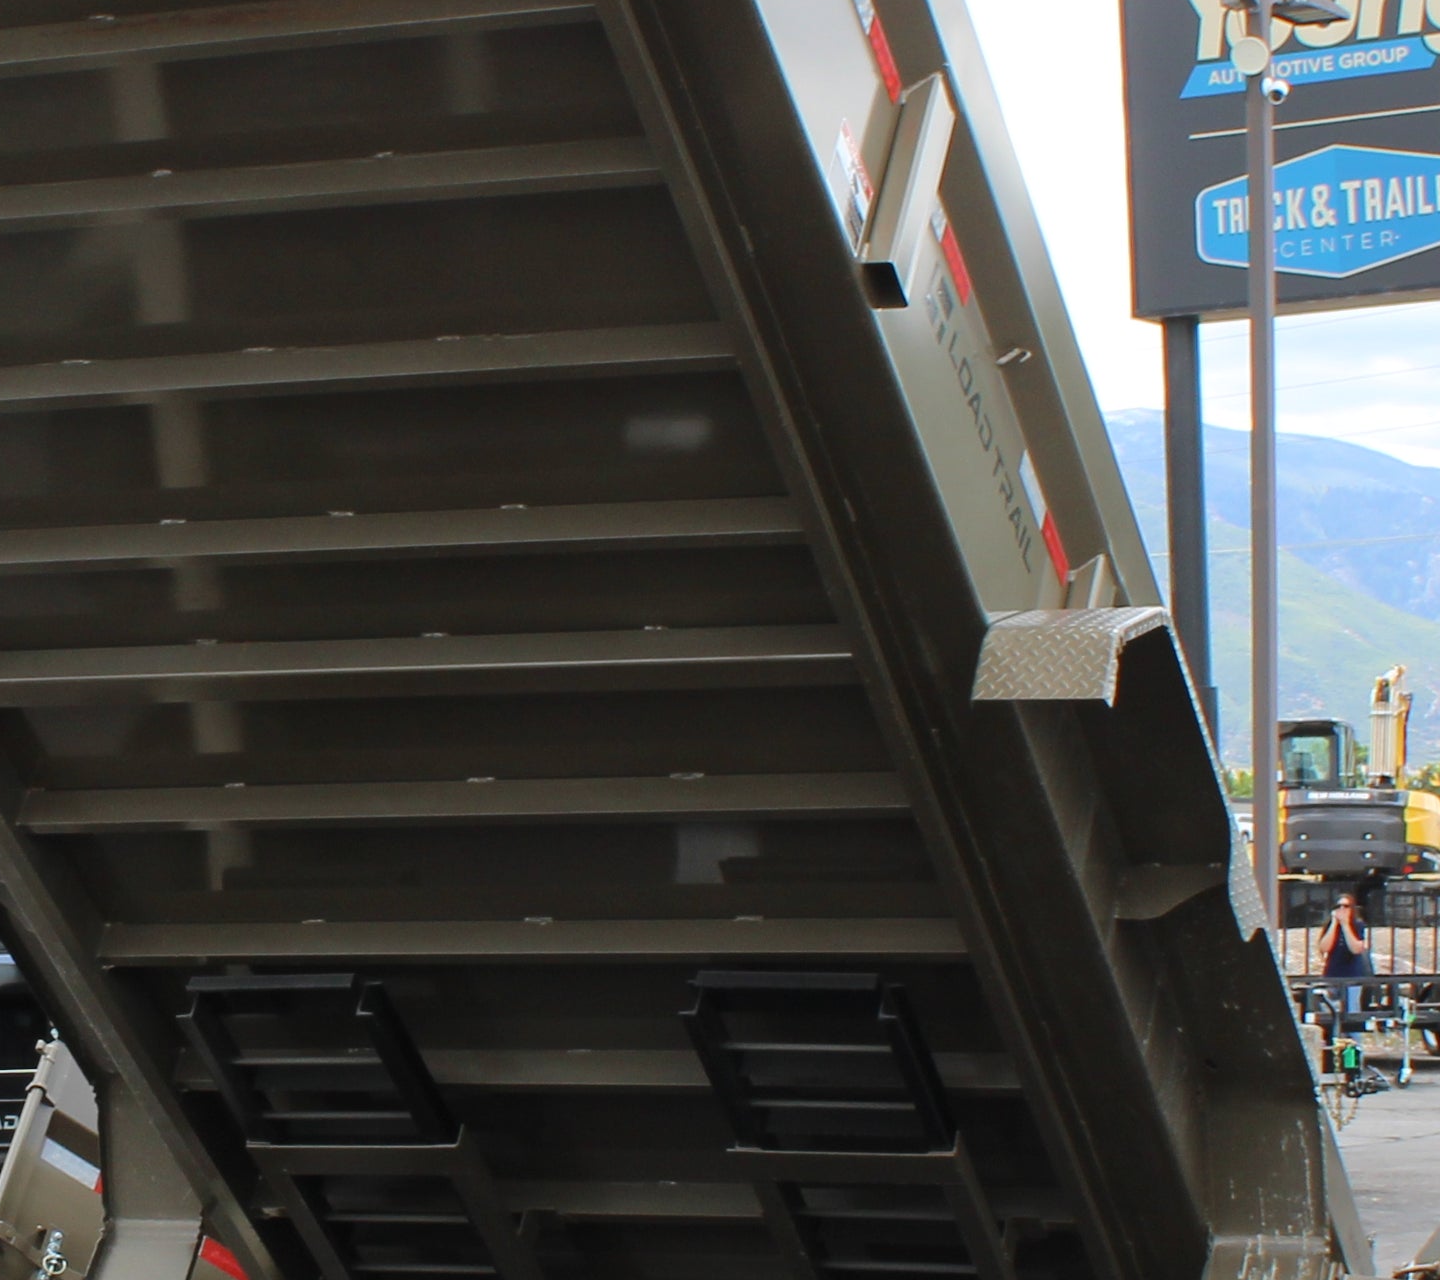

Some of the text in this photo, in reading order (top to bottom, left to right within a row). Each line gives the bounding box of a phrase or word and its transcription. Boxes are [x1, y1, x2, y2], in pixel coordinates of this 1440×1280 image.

[1208, 45, 1410, 86] AUTOTIVE GROUP
[1212, 187, 1307, 236] TRCK
[1310, 184, 1338, 228] &
[1279, 229, 1396, 259] CENTER
[948, 329, 1031, 574] LOAD TRAIL
